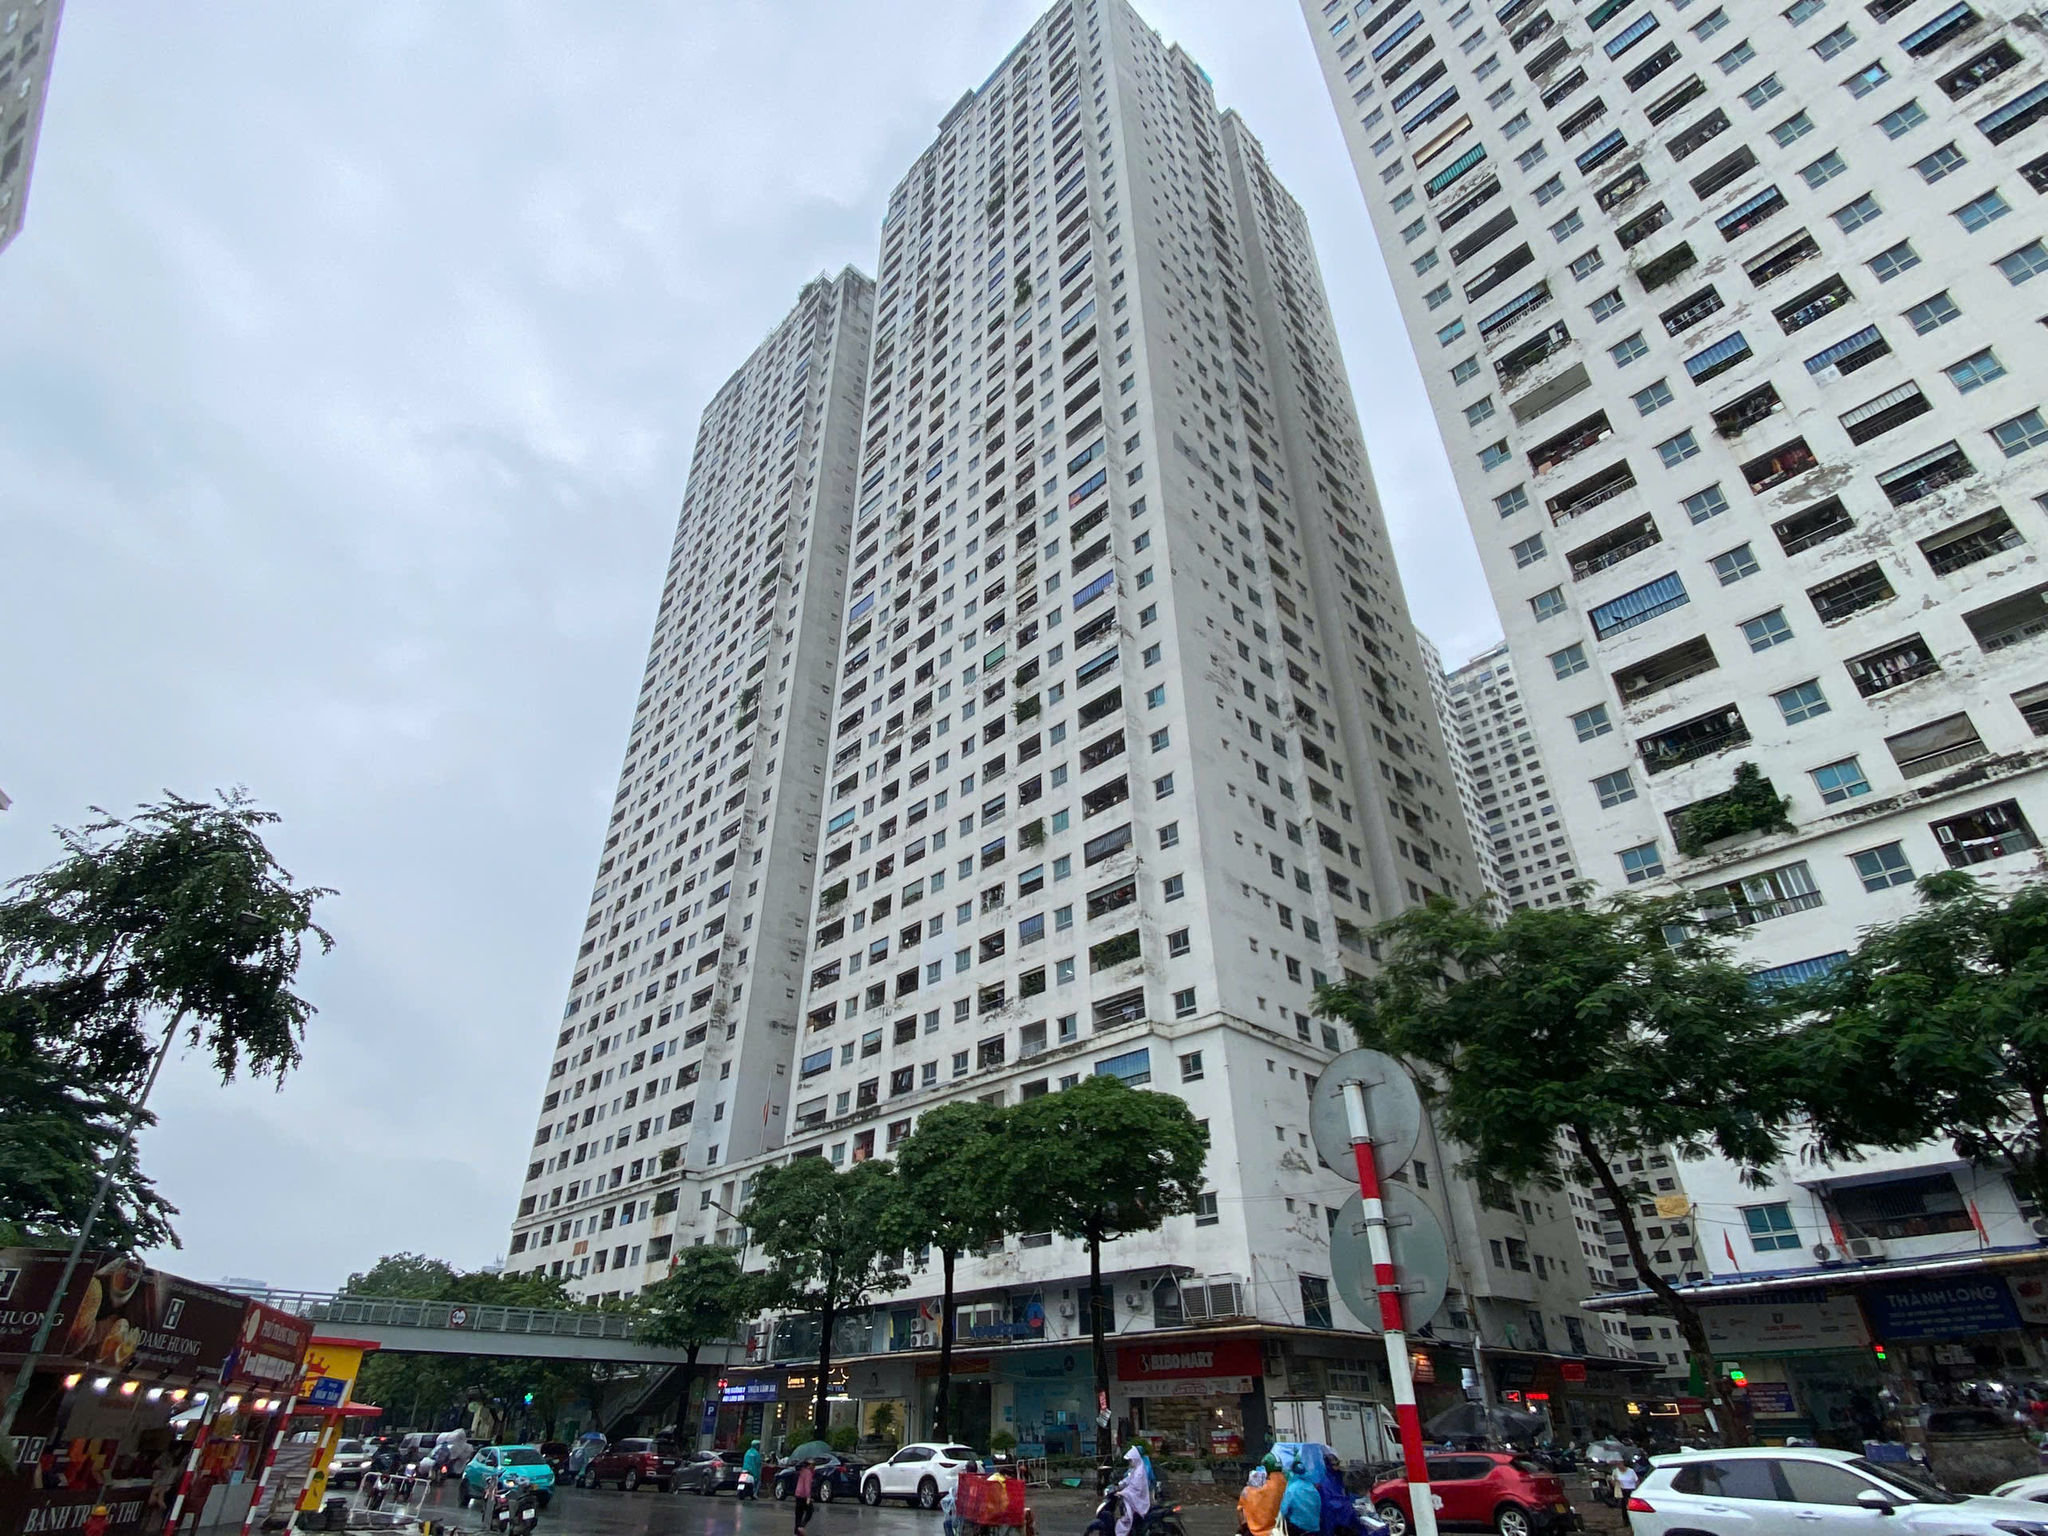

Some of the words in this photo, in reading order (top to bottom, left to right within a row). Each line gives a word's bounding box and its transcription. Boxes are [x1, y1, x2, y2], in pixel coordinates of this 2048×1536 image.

[138, 1330, 169, 1350] DAME
[167, 1336, 202, 1356] HUONG
[1181, 1351, 1214, 1368] MART
[707, 1407, 715, 1415] P
[23, 1500, 73, 1533] BÁNH
[71, 1502, 118, 1528] TRG
